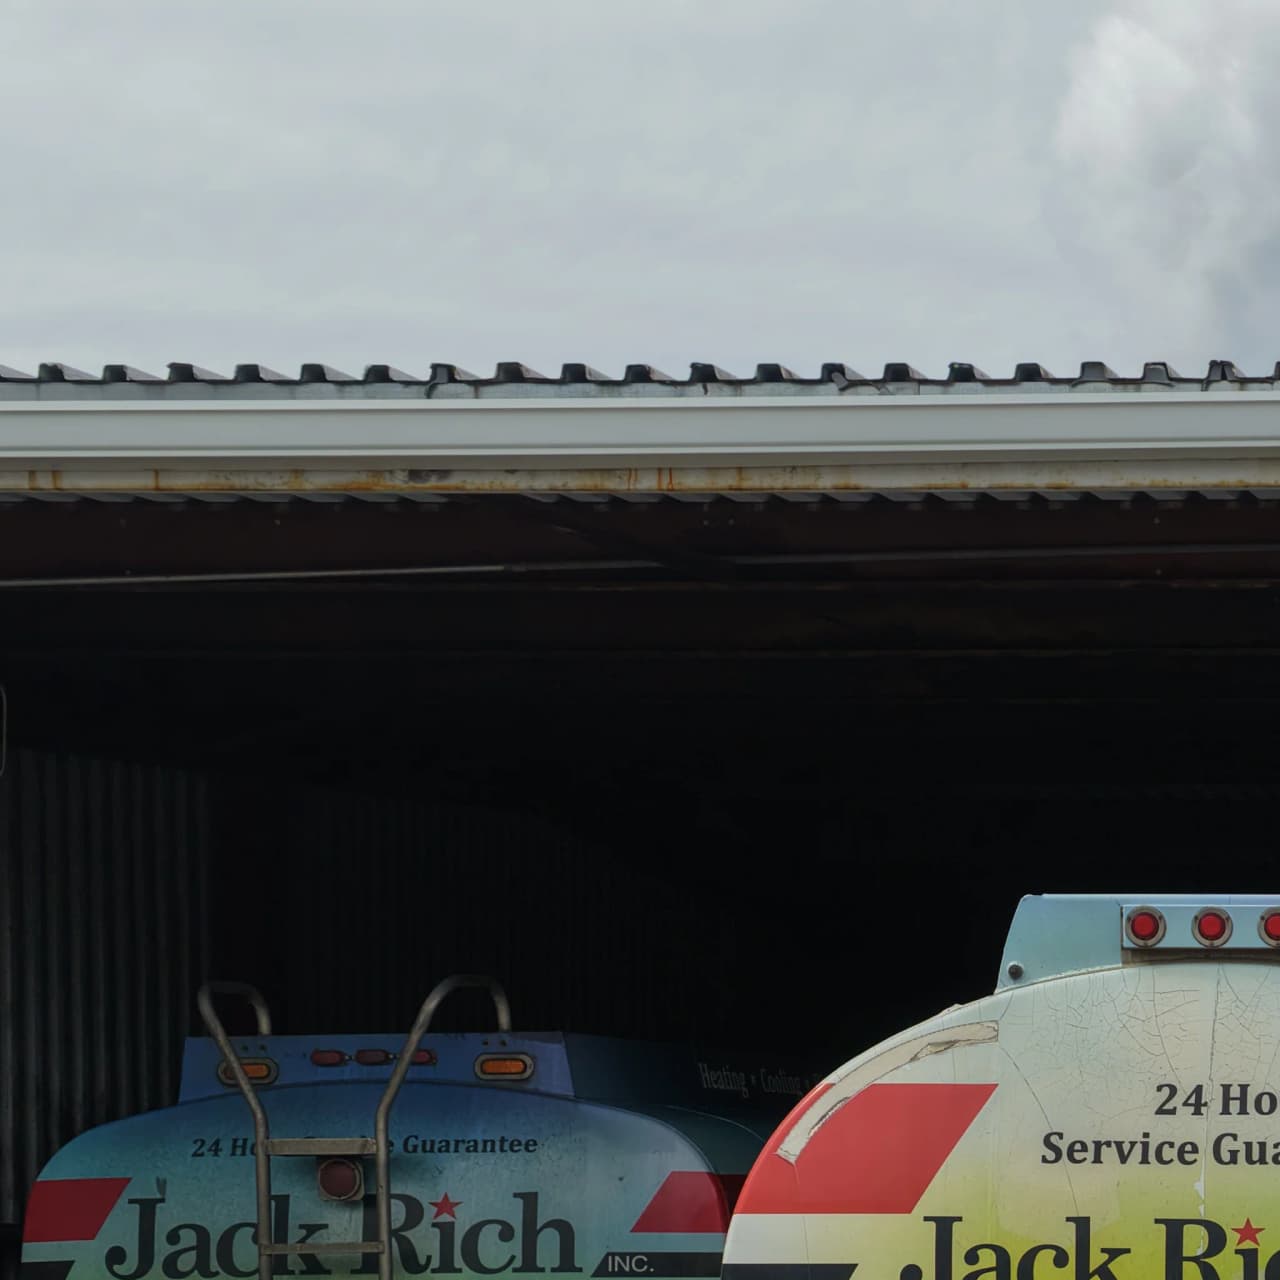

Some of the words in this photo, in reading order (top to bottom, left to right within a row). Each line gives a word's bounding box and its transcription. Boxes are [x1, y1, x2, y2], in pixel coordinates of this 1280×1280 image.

[1154, 1083, 1208, 1116] 24
[192, 1138, 222, 1157] 24
[403, 1135, 538, 1153] Guarantee
[1041, 1131, 1199, 1166] Service
[105, 1194, 332, 1280] Jack
[350, 1191, 583, 1275] Rich
[607, 1254, 655, 1273] INC.
